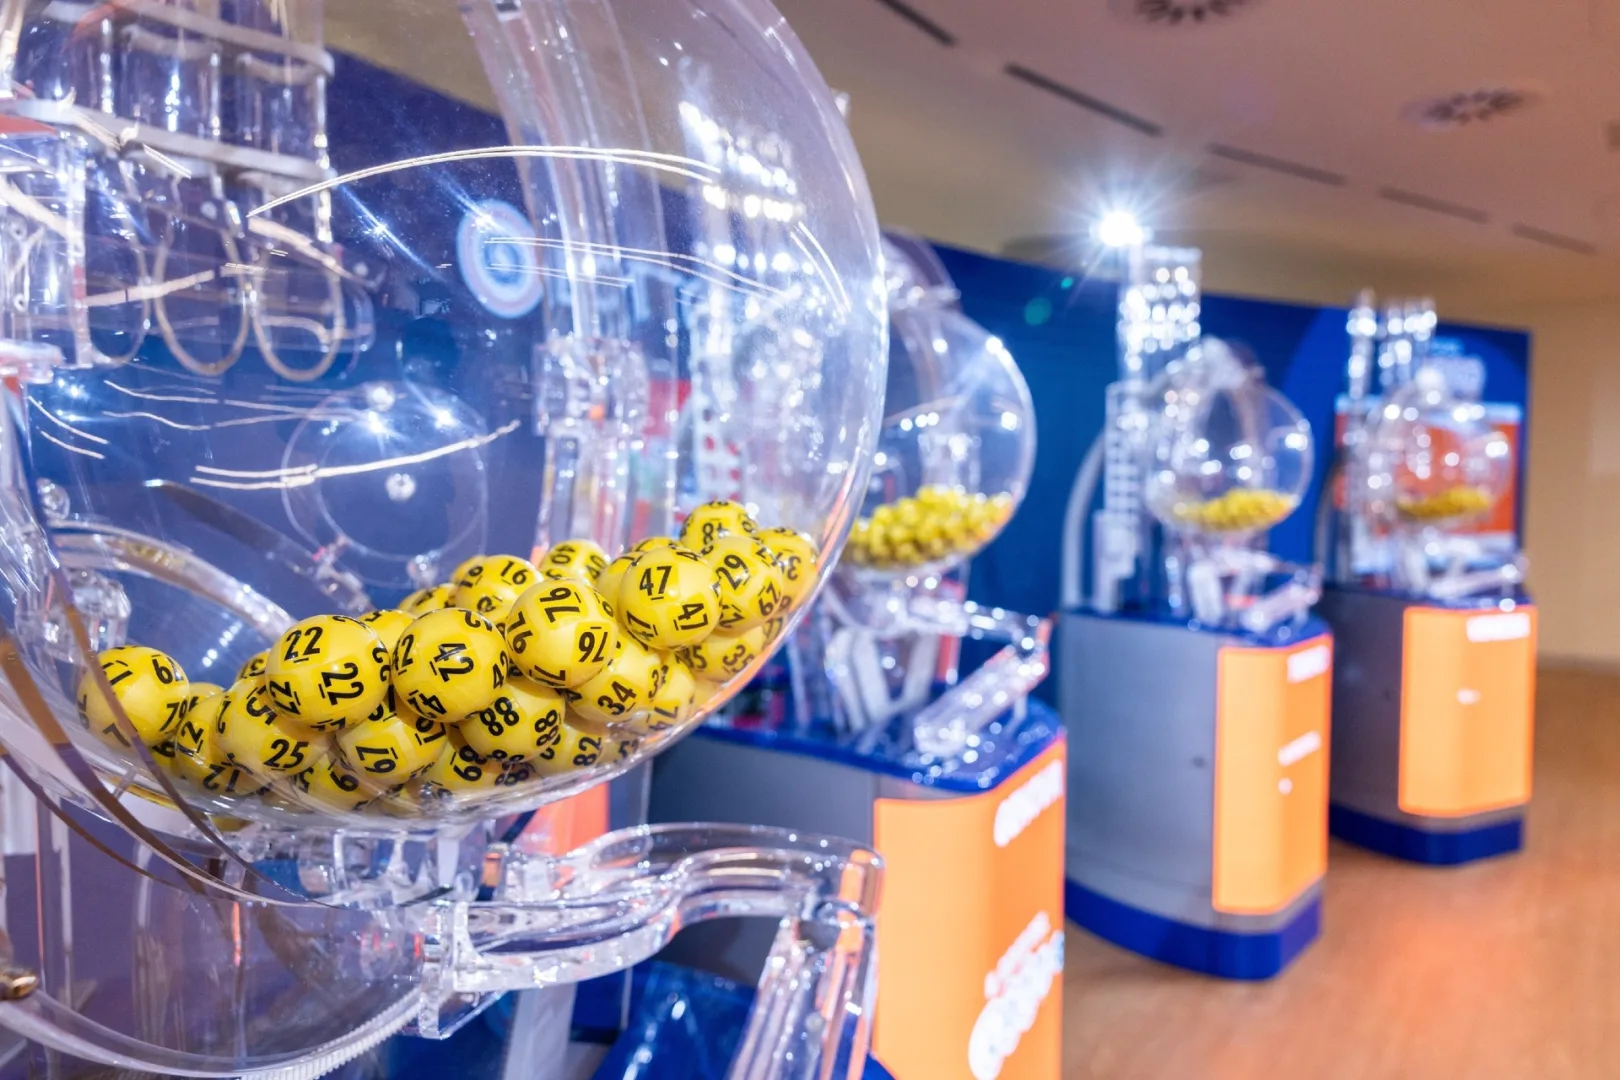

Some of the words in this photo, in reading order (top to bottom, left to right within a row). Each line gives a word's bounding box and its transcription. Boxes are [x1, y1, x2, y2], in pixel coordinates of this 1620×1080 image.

[501, 561, 529, 585] 16
[639, 565, 672, 598] 47
[539, 587, 580, 623] 76
[675, 602, 709, 632] 47
[284, 626, 323, 662] 22
[506, 611, 533, 653] 76
[578, 628, 608, 663] 76
[431, 643, 474, 682] 42
[320, 662, 364, 706] 22
[598, 681, 636, 716] 34
[480, 696, 519, 737] 88
[264, 738, 309, 771] 25
[355, 745, 398, 774] 67
